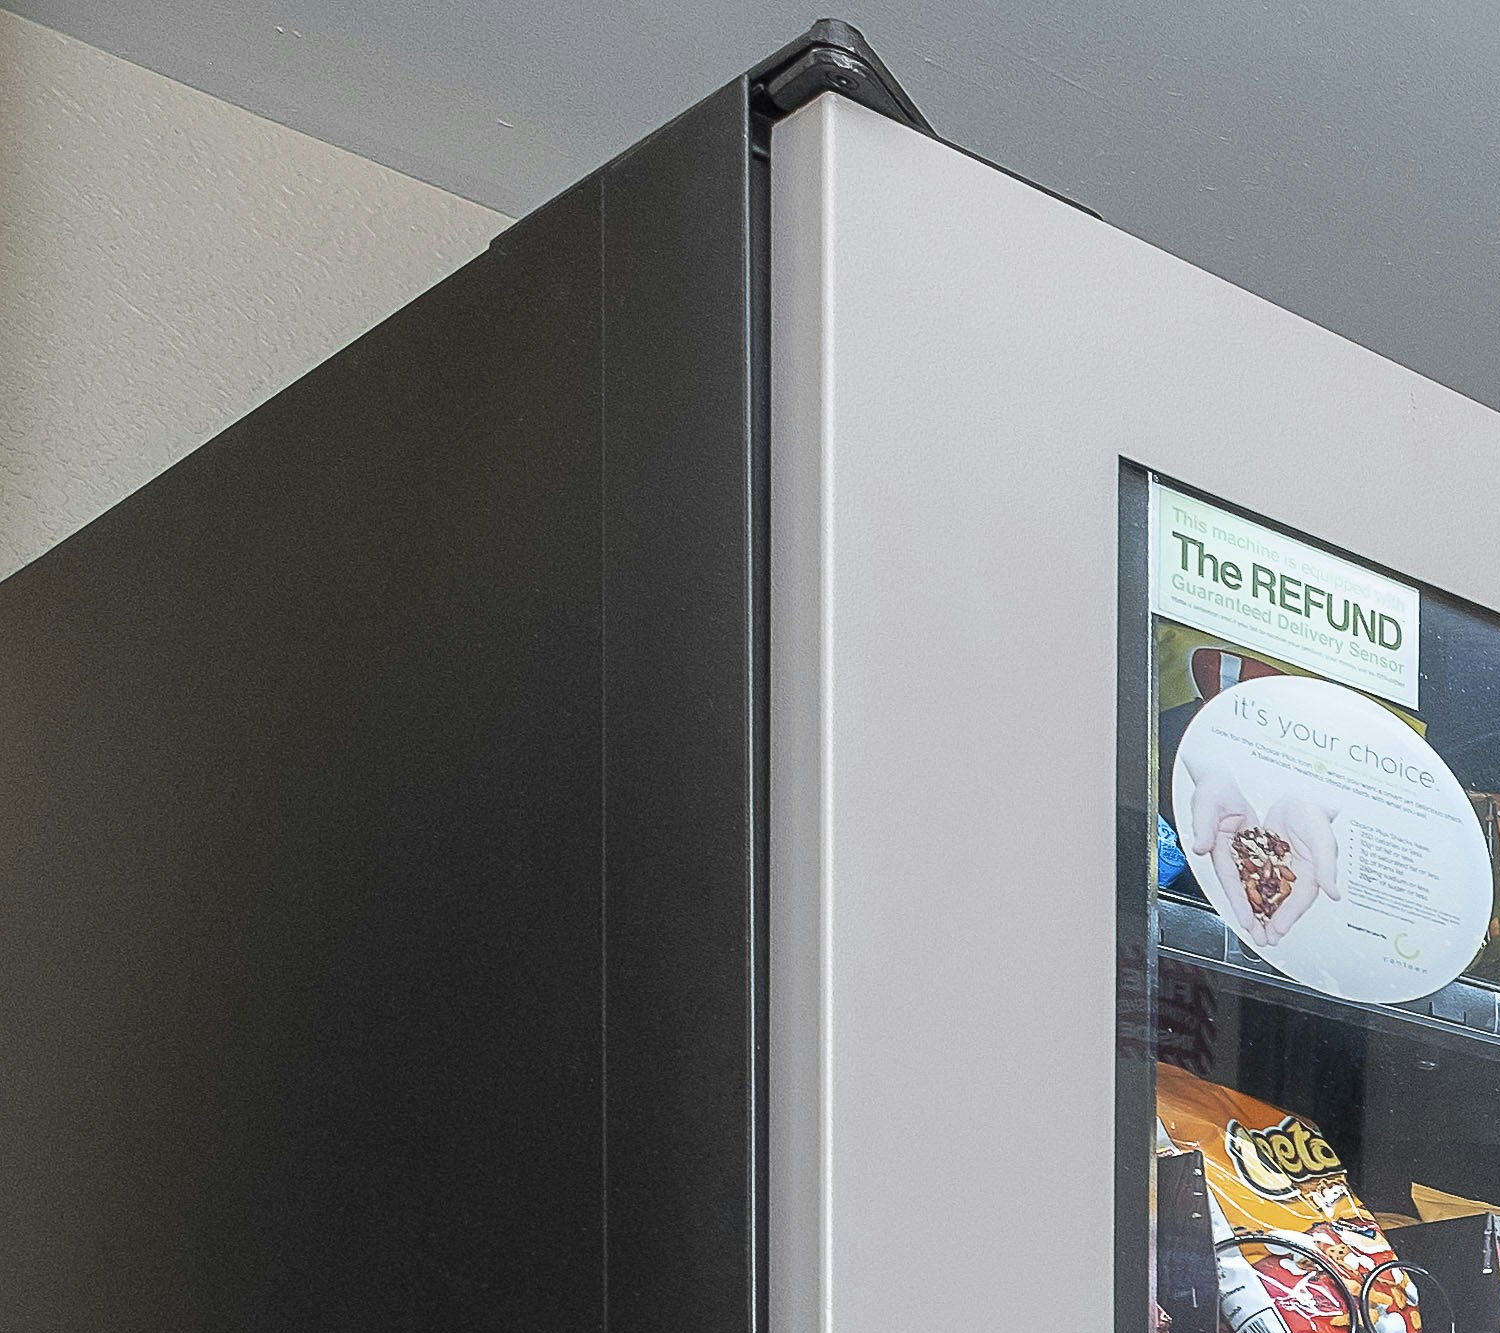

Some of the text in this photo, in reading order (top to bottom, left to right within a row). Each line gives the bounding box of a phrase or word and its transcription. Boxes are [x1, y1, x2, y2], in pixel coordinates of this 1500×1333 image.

[1171, 530, 1242, 593] The
[1251, 561, 1402, 655] REFUND
[1171, 571, 1272, 626] Guaranteed
[1277, 612, 1343, 656] Delivery
[1348, 640, 1404, 677] Sensor
[1233, 694, 1268, 726] it's
[1277, 715, 1340, 752] your
